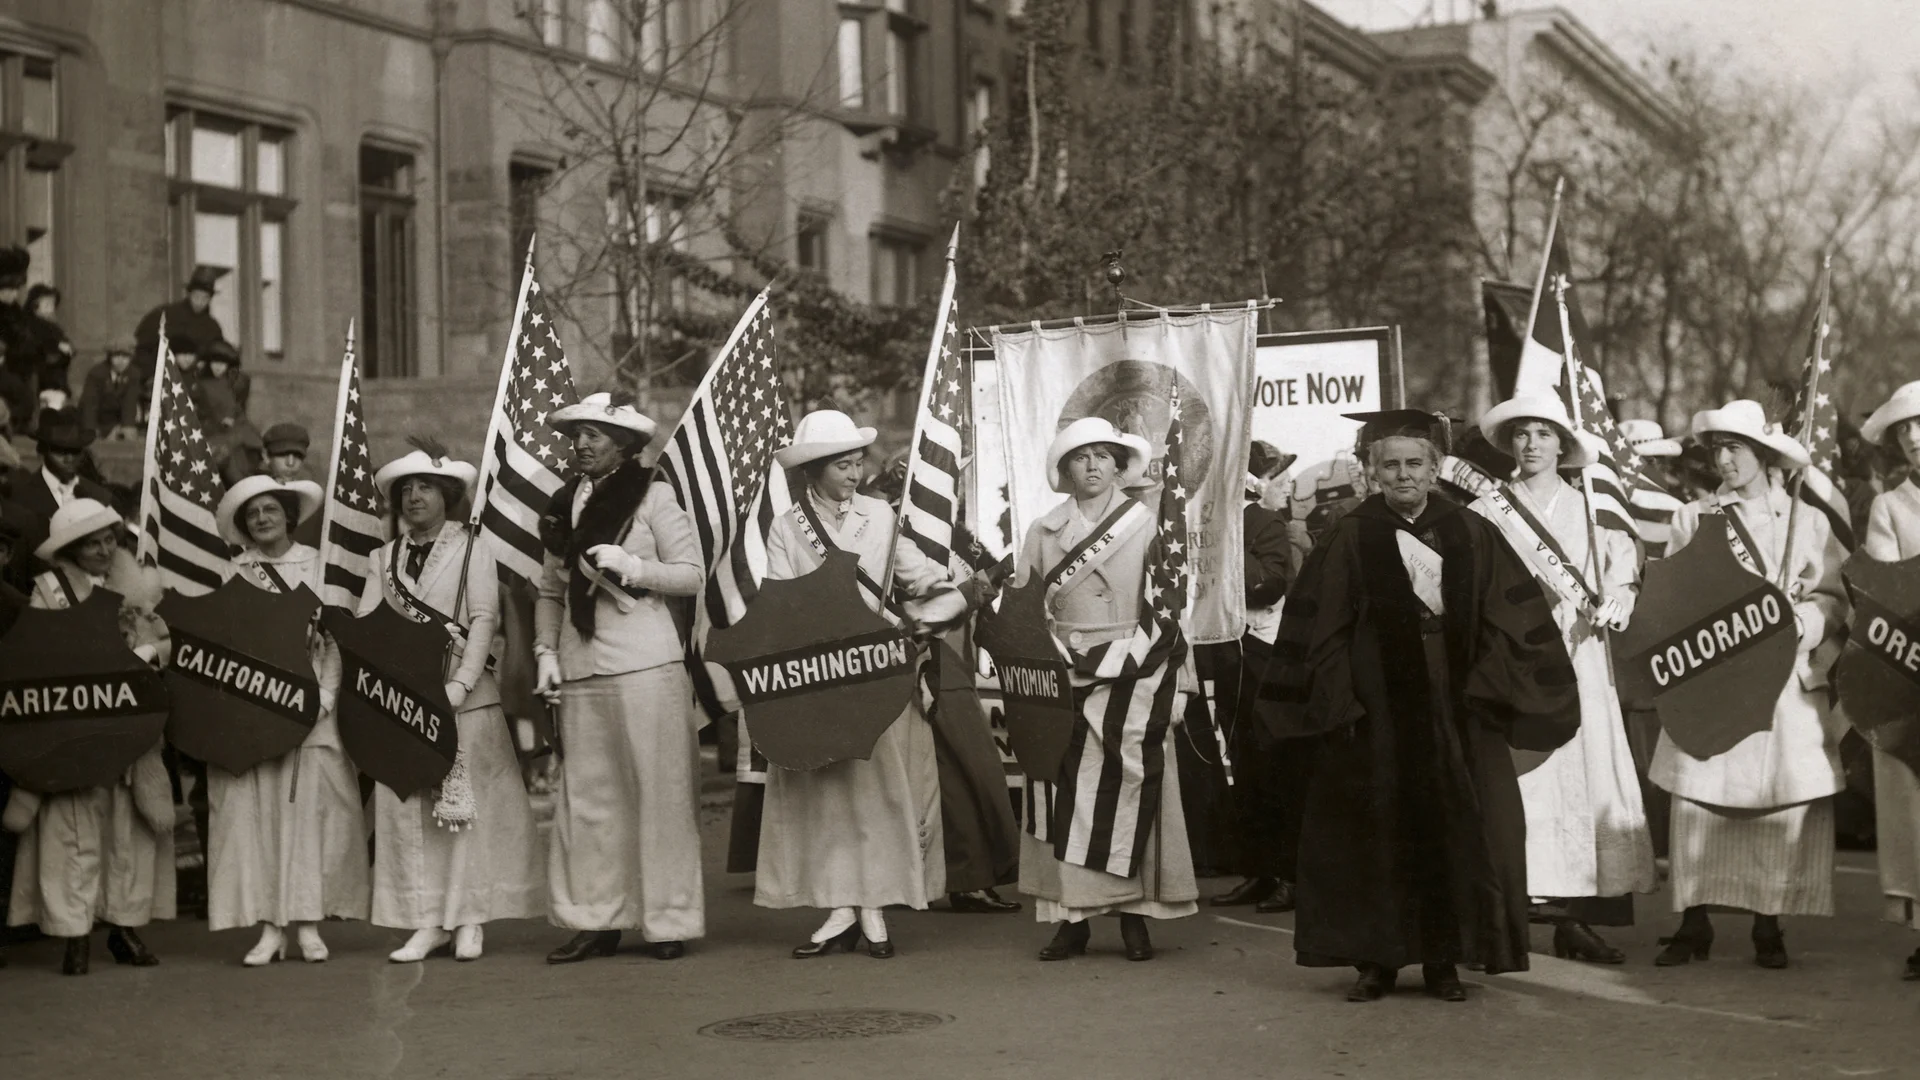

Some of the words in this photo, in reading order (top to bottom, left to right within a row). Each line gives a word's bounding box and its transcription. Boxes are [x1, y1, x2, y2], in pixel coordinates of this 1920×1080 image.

[1306, 372, 1364, 404] NOW
[792, 505, 829, 560] VOTER
[1052, 532, 1115, 587] VOTER
[741, 638, 907, 695] WASHINGTON
[1650, 593, 1781, 686] COLORADO
[1, 682, 137, 716] ARIZONA
[176, 644, 305, 713] CALIFORNIA
[356, 667, 441, 743] KANSAS
[1000, 665, 1059, 698] WYOMING
